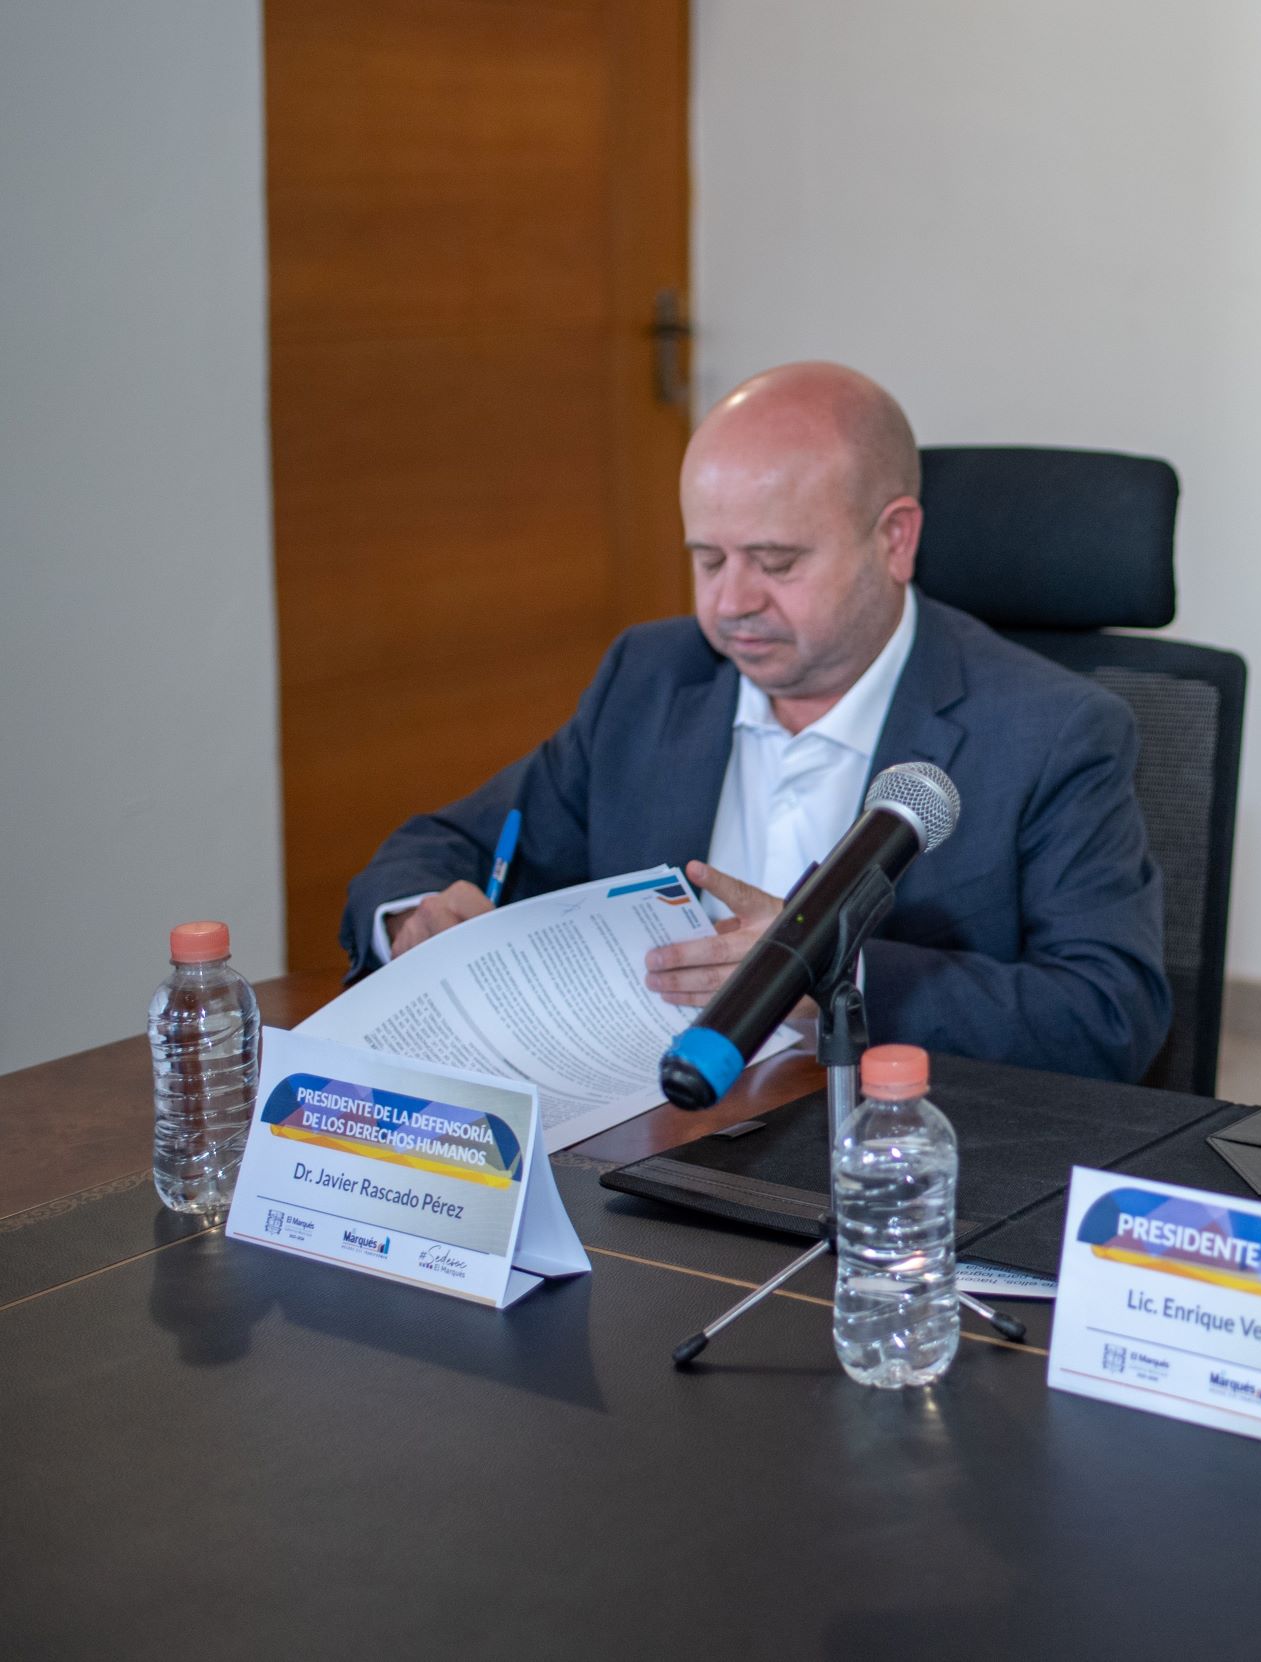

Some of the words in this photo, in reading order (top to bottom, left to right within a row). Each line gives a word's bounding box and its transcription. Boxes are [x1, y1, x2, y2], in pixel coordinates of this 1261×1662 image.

[297, 1087, 372, 1119] PRESIDENTE
[373, 1102, 391, 1121] DE
[391, 1106, 409, 1125] LA
[411, 1110, 494, 1145] DEFENSORÍA
[303, 1110, 320, 1129] DE
[321, 1114, 345, 1135] LOS
[346, 1119, 415, 1150] DERECHOS
[416, 1135, 487, 1166] HUMANOS
[294, 1161, 312, 1185] Dr.
[315, 1166, 358, 1195] Javier
[359, 1177, 419, 1209] Rascado
[422, 1190, 464, 1220] Pérez
[343, 1229, 378, 1251] Marqués
[1117, 1212, 1261, 1268] PRESIDENTE
[1127, 1289, 1157, 1314] Lic.
[1163, 1295, 1235, 1335] Enrique
